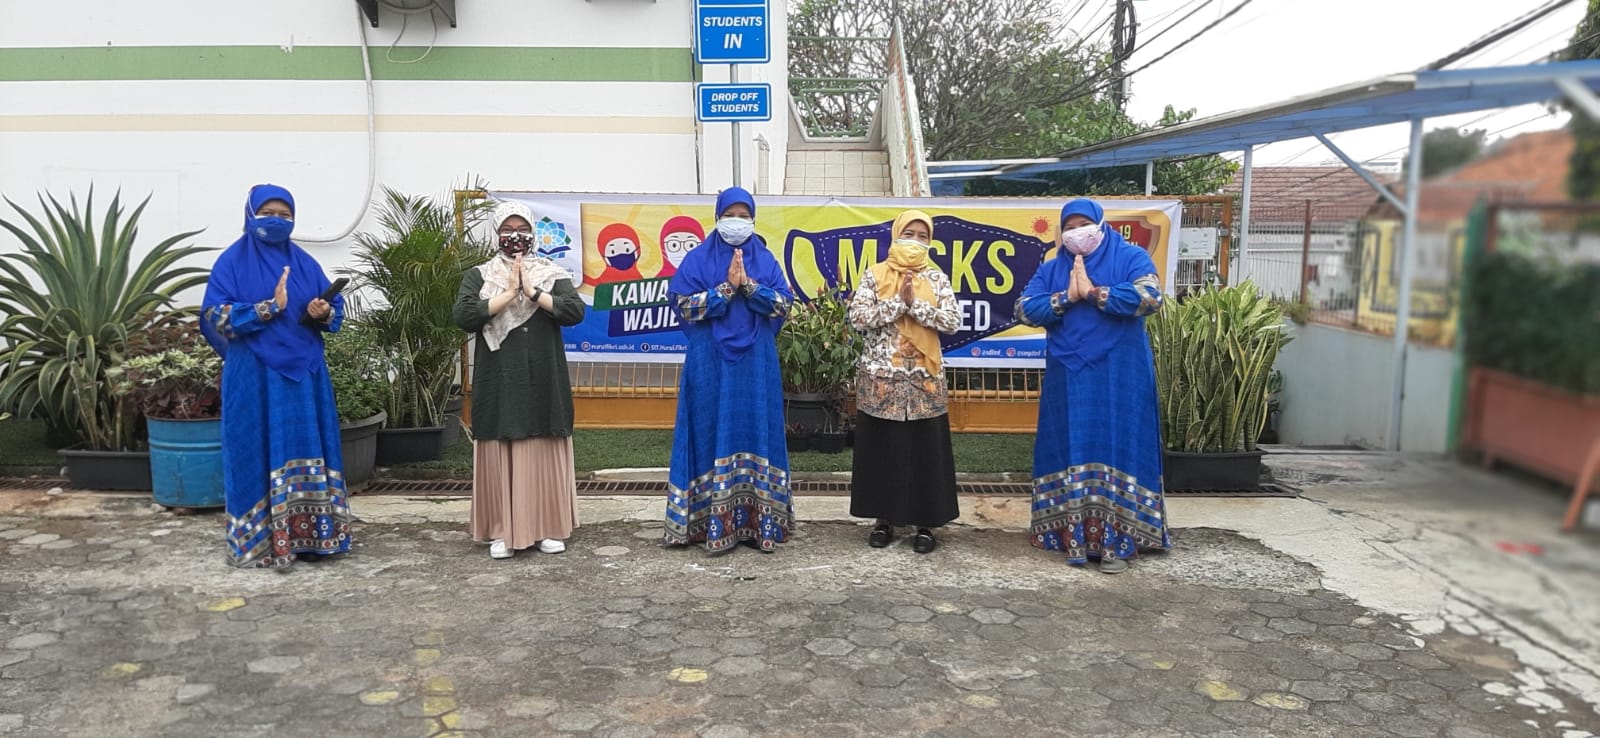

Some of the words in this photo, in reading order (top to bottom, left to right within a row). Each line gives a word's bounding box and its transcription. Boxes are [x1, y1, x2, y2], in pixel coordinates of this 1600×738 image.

[703, 16, 763, 27] STUDENTS
[723, 33, 743, 49] IN
[711, 92, 738, 102] DROP
[740, 92, 759, 102] OFF
[710, 103, 760, 113] STUDENTS
[838, 239, 1016, 295] MKS
